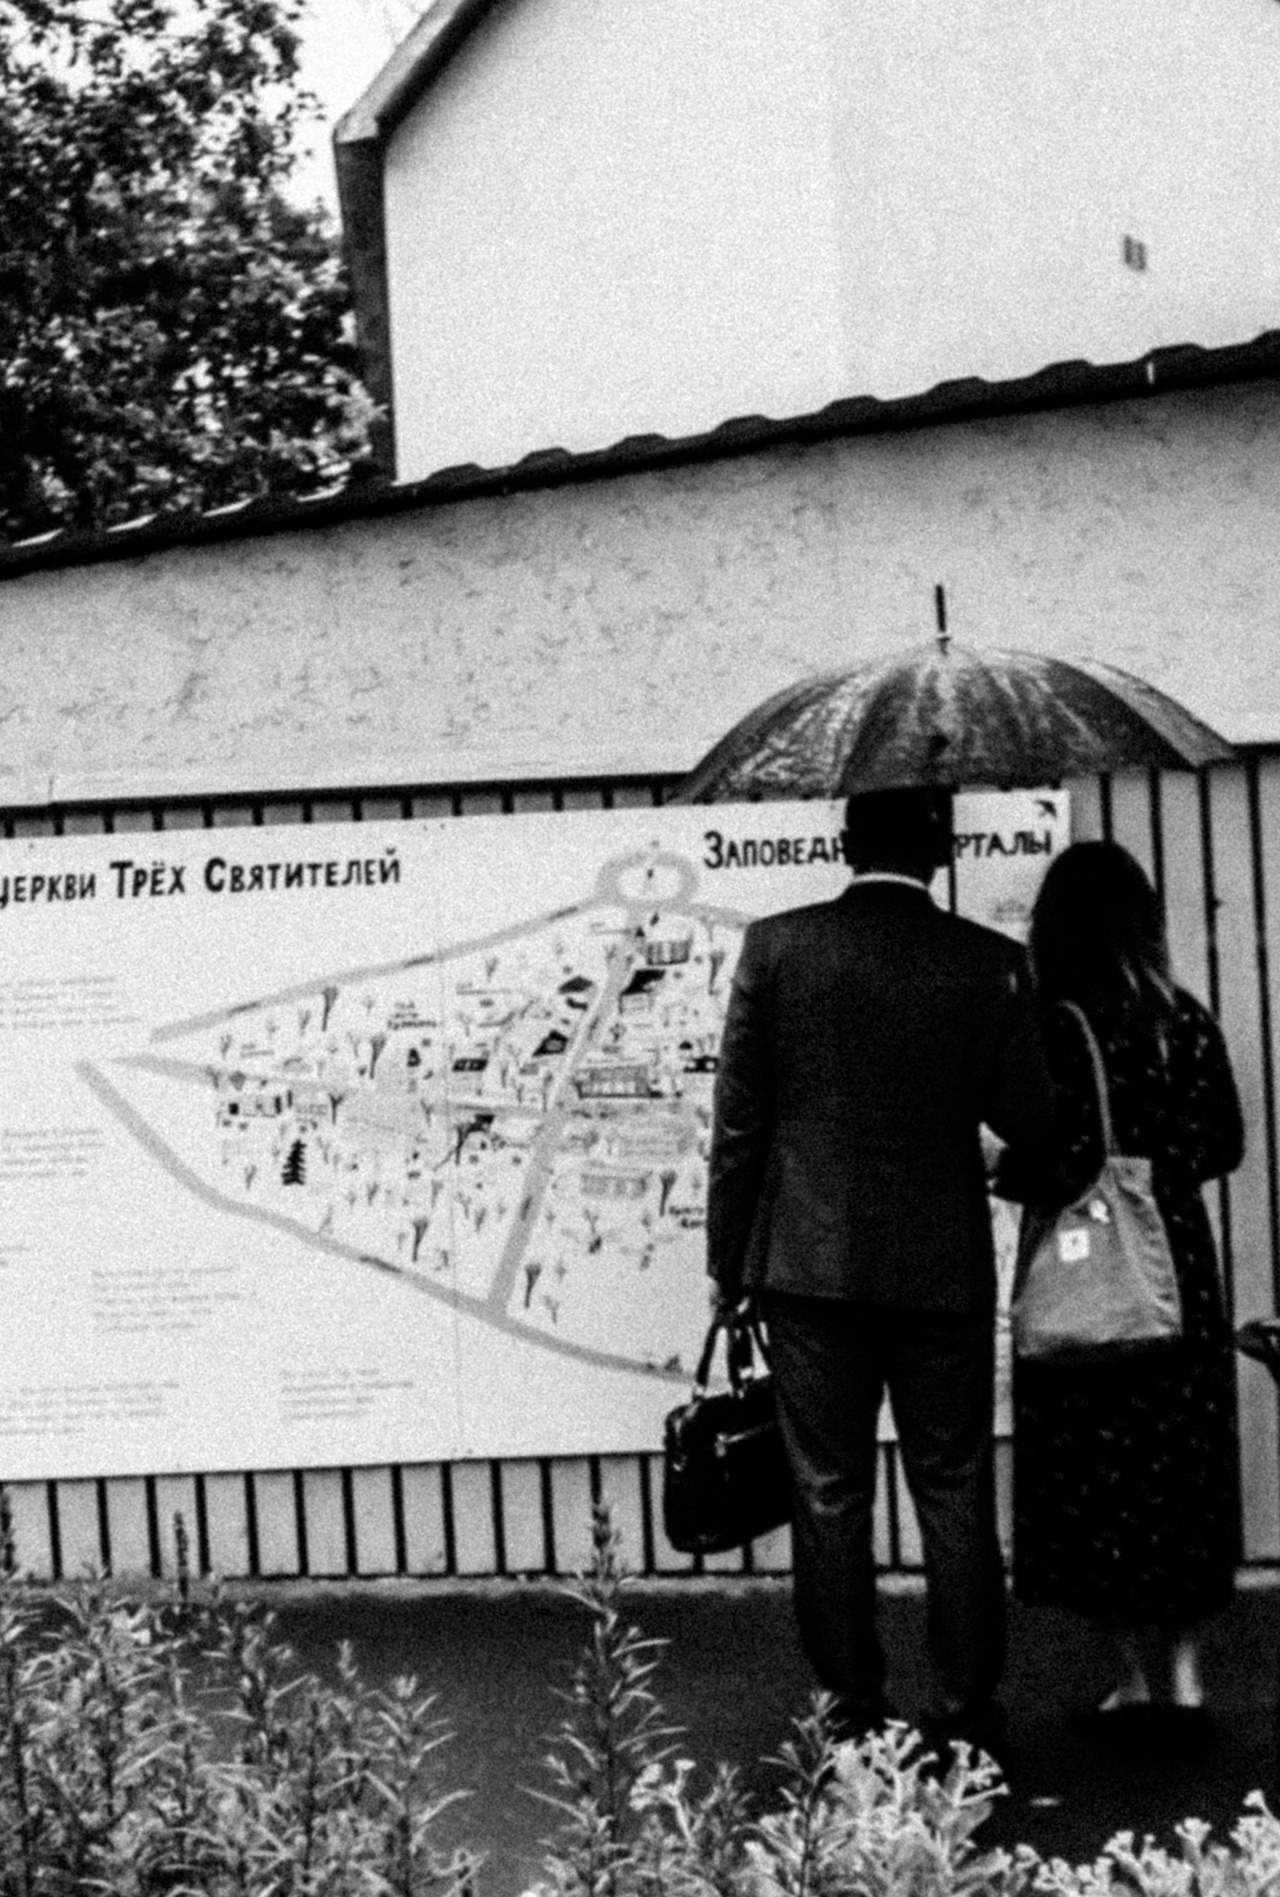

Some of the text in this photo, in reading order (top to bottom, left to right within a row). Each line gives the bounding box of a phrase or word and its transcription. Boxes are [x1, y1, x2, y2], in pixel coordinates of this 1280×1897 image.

[703, 830, 1052, 869] ЗАПОВЕДН РТАЛЫ
[108, 860, 188, 900] ТРЁХ
[203, 847, 402, 894] СВЯТИТЕЛЕЙ
